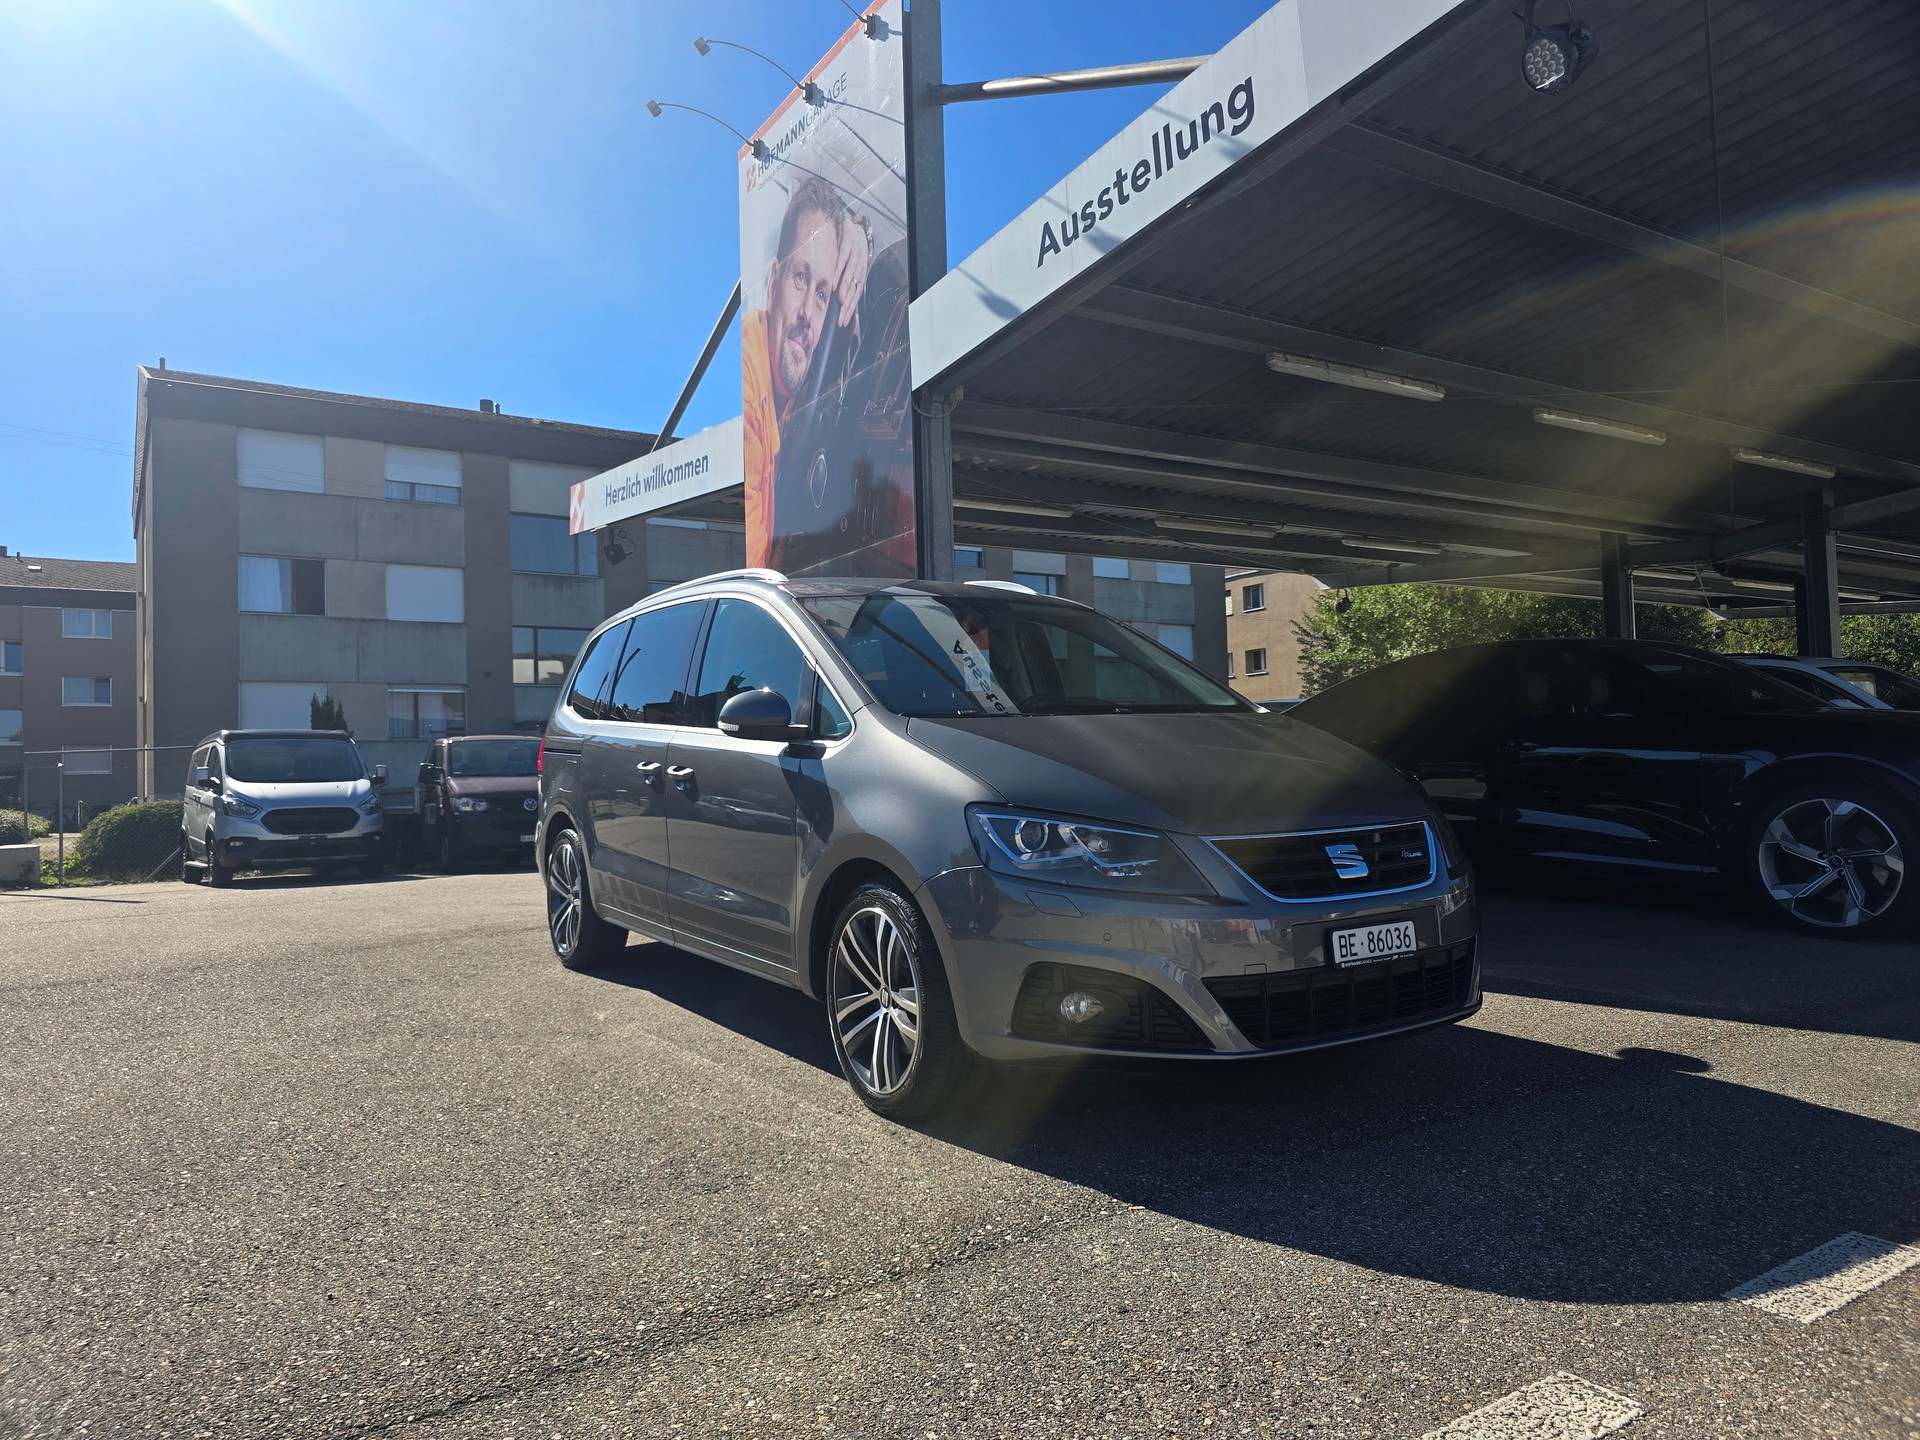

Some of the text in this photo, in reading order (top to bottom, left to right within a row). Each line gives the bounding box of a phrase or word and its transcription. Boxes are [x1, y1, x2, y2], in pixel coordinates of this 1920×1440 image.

[1037, 75, 1255, 268] Ausstellung
[605, 454, 709, 506] Herzlich willkommen
[1338, 925, 1412, 958] BE 86036
